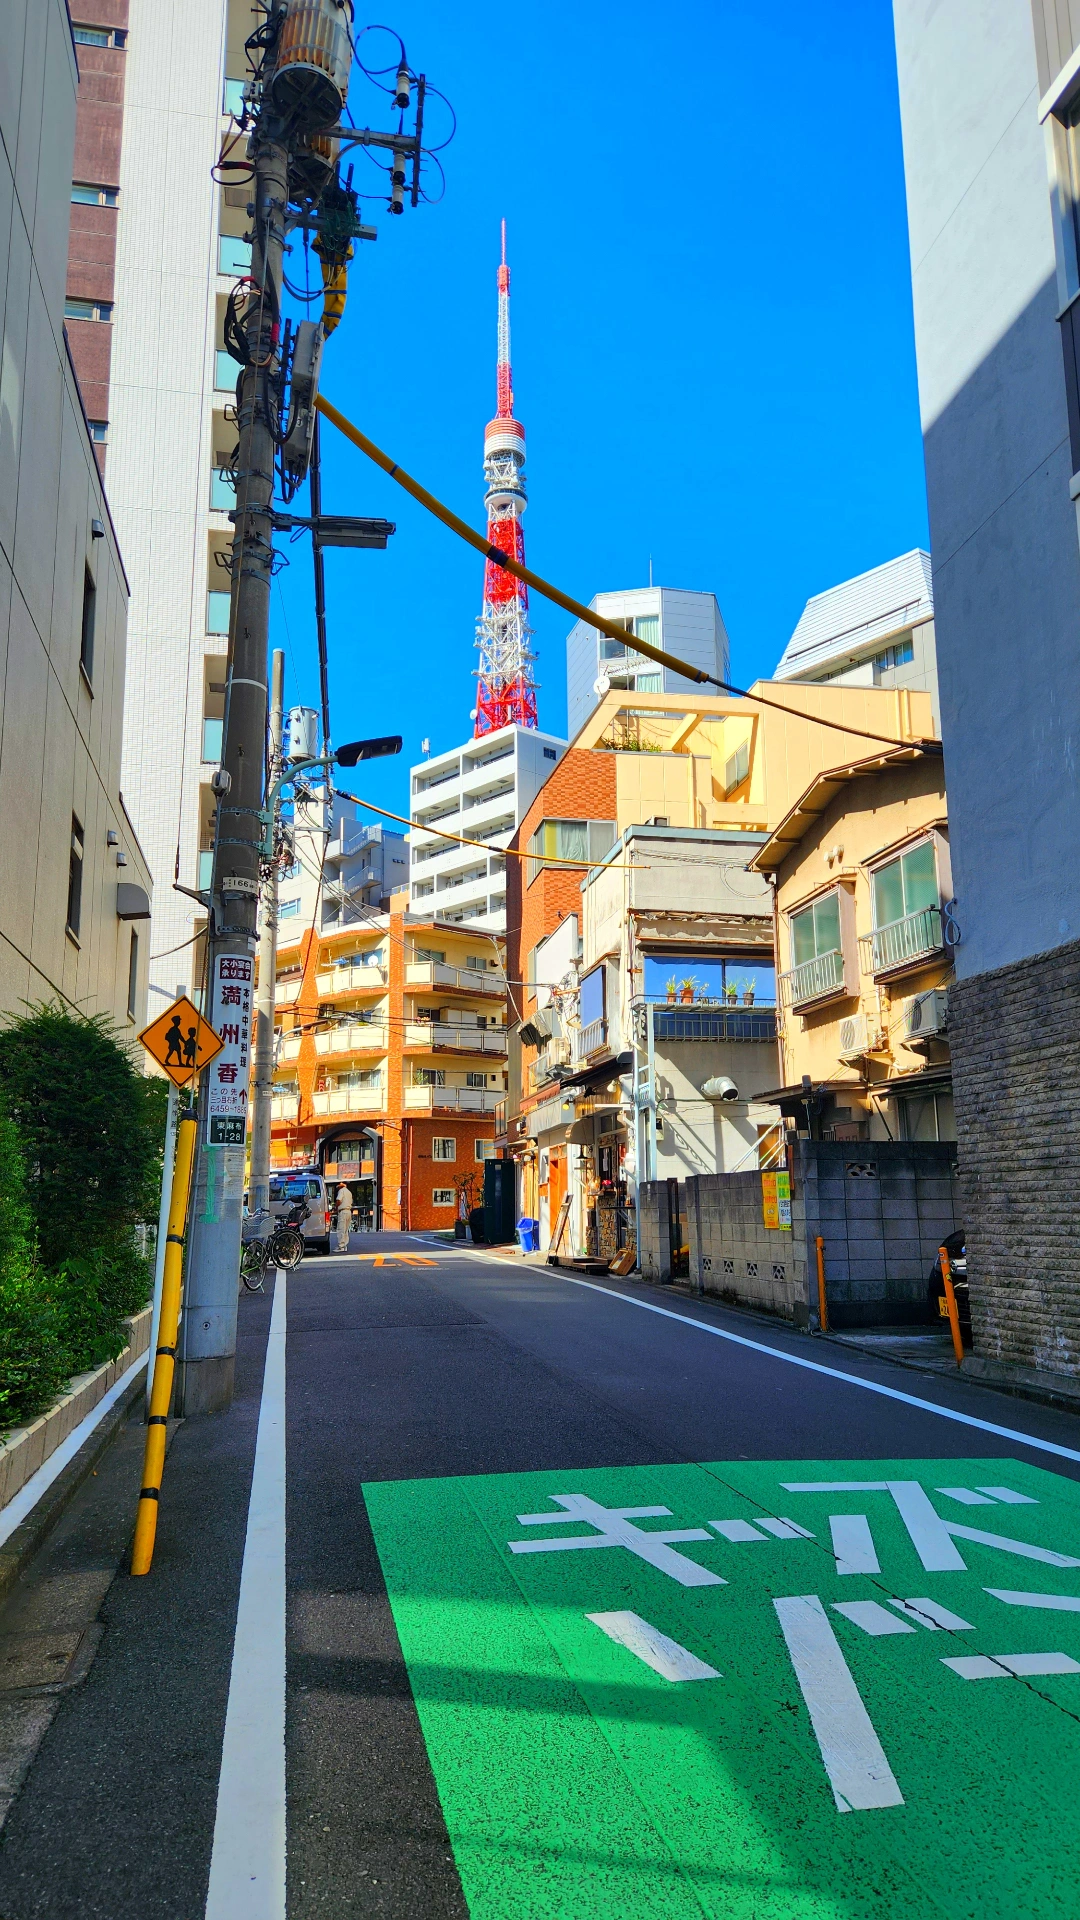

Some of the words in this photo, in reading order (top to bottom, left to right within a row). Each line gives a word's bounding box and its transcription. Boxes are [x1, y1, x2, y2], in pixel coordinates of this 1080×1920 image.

[221, 969, 251, 979] 承ります
[240, 988, 250, 1067] 本格中華料理
[218, 985, 241, 1084] 満州香
[211, 1088, 238, 1096] この先
[216, 1121, 242, 1131] 東麻布
[218, 1132, 241, 1141] 1-28
